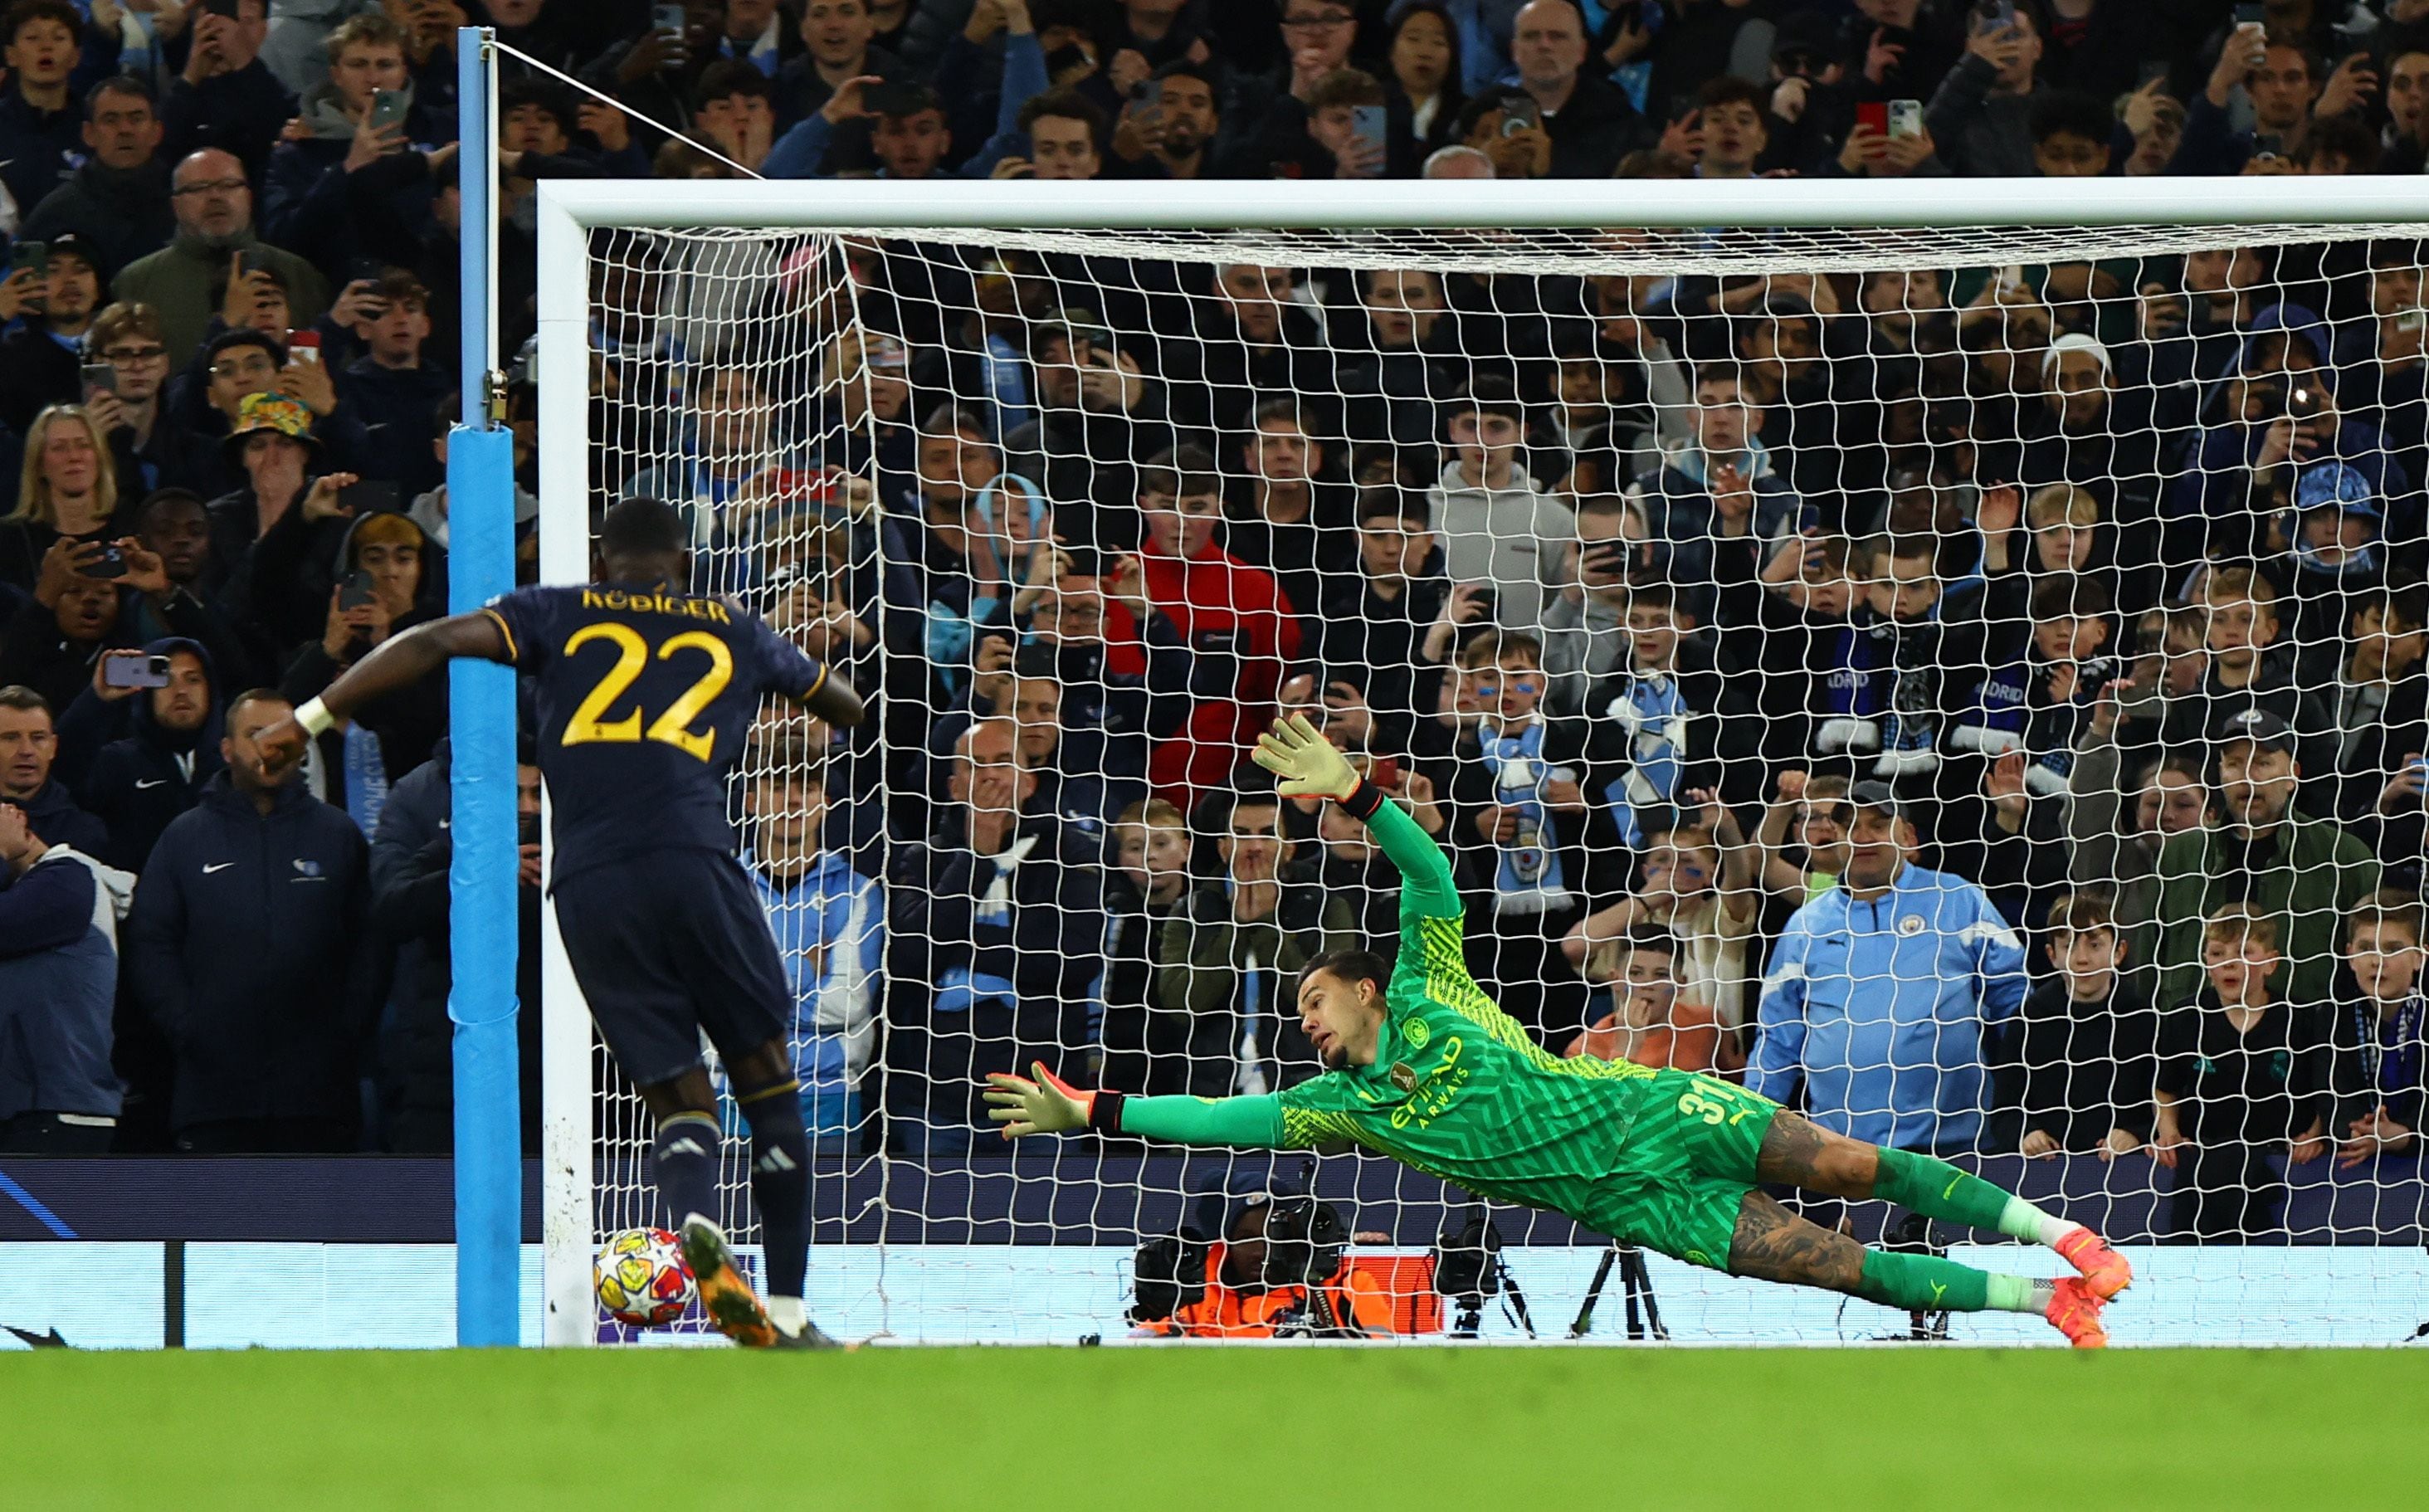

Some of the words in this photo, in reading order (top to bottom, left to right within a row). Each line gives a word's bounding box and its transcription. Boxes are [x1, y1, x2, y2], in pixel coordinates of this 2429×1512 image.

[561, 622, 734, 762] 22
[1418, 1067, 1469, 1129] ARWAYS
[1678, 1079, 1735, 1124] 31
